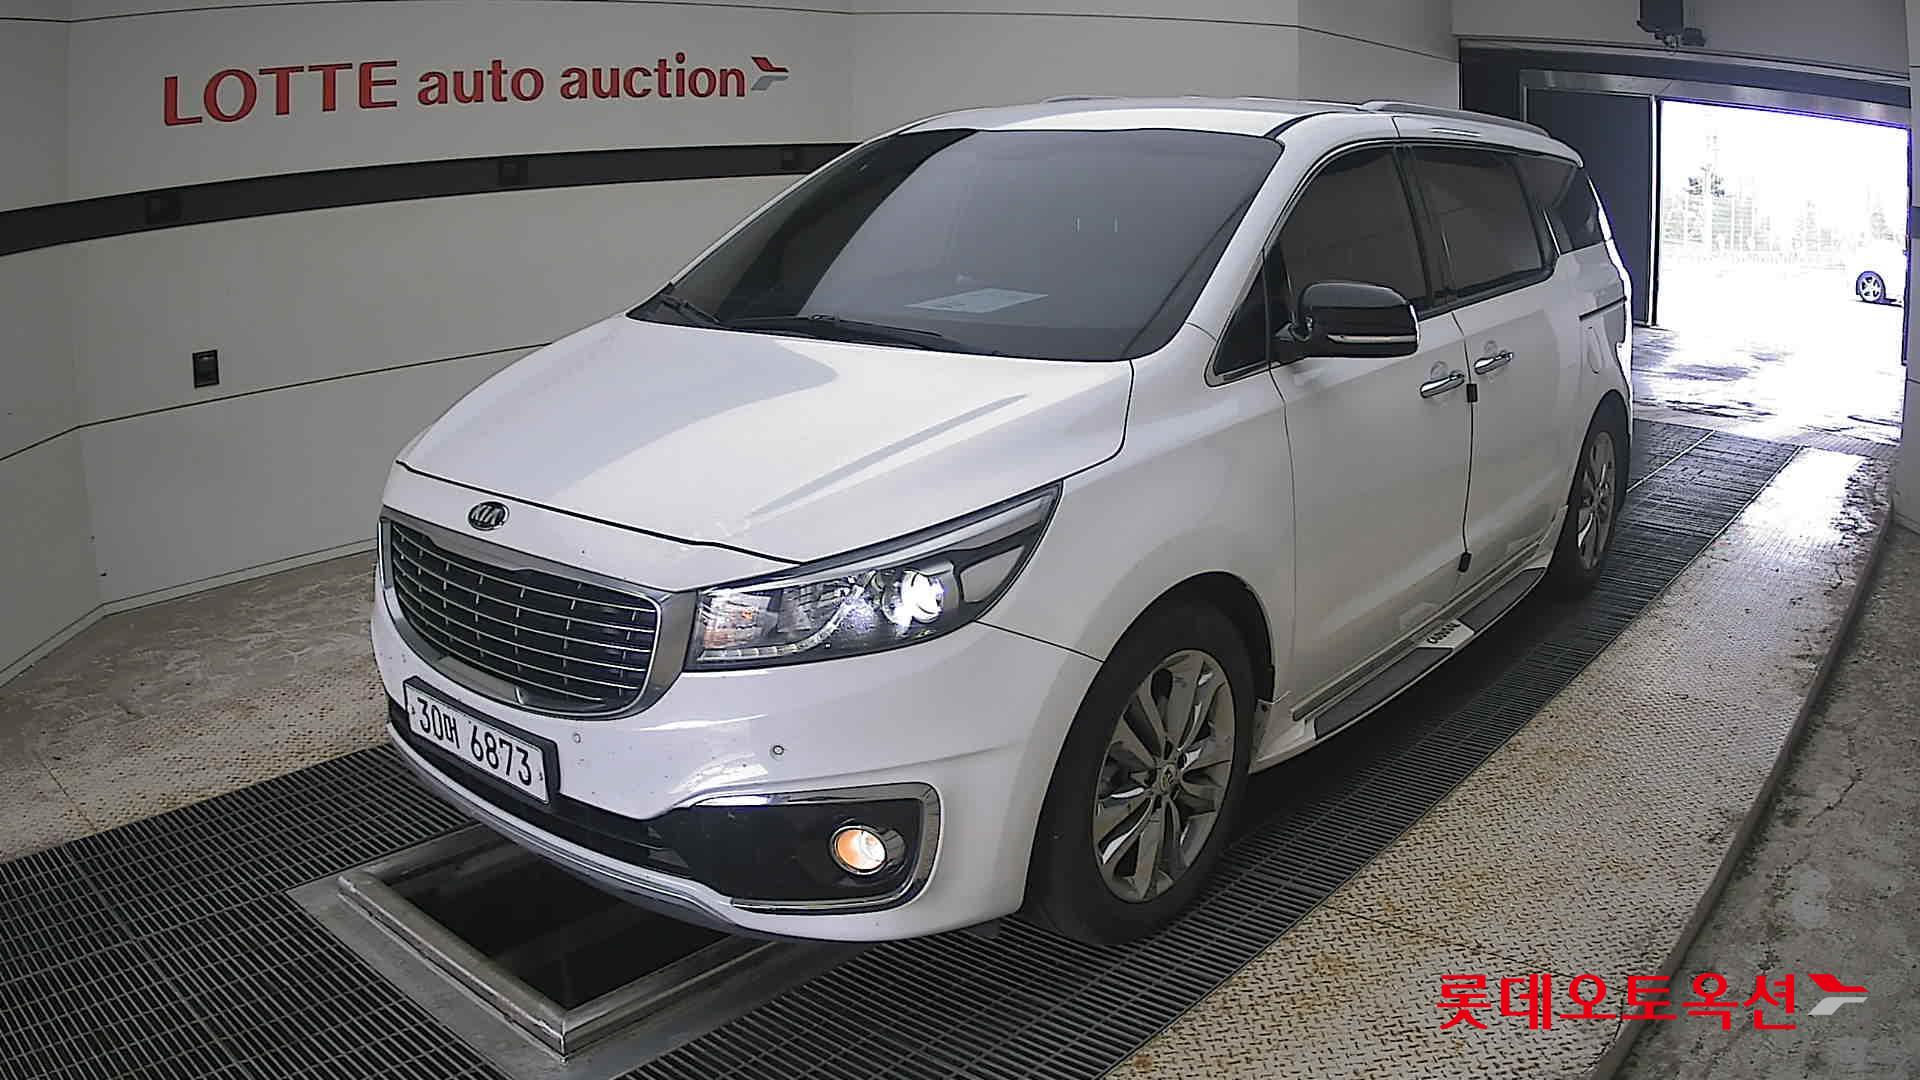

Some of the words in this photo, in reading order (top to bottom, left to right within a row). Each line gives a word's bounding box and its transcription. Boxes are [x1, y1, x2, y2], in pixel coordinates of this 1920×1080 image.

[163, 60, 398, 126] LOTTE
[416, 59, 545, 105] auto
[559, 51, 746, 99] auction
[417, 697, 460, 749] 30머
[471, 725, 531, 786] 6873
